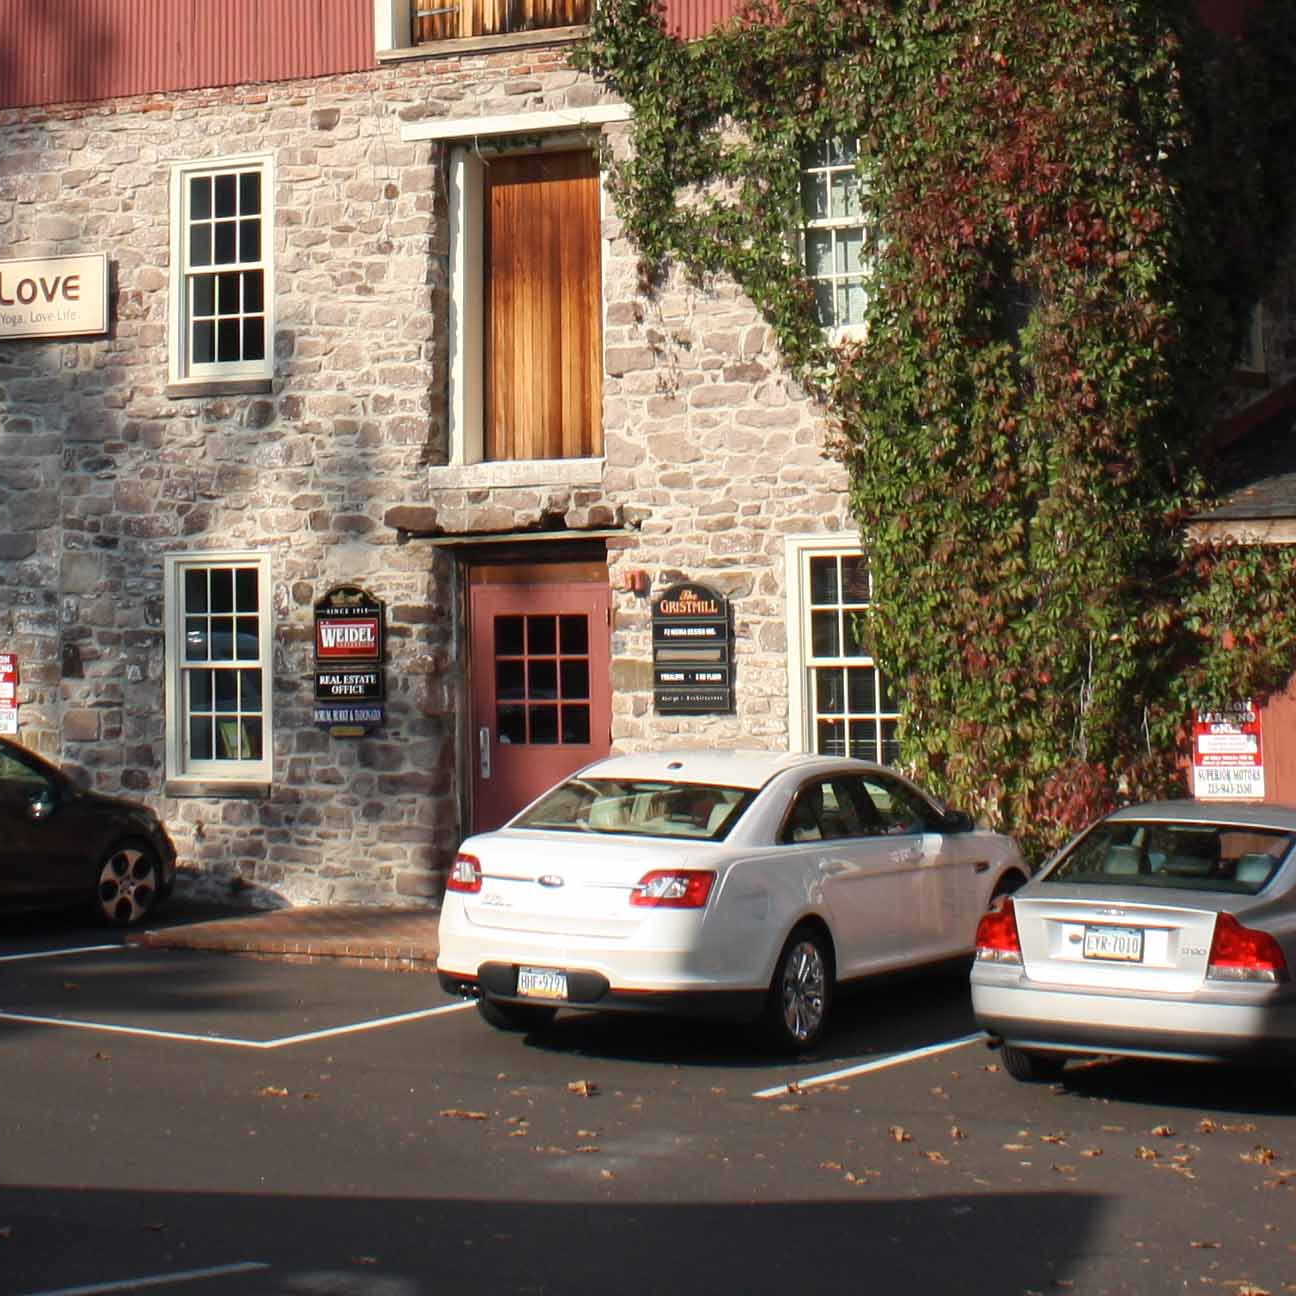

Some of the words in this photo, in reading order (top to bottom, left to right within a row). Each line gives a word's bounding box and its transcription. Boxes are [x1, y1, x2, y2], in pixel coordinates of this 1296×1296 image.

[30, 311, 54, 323] Love
[680, 589, 698, 601] The
[660, 600, 718, 613] GRISTMILL
[320, 627, 375, 648] WEIDEL
[319, 675, 342, 685] REAL
[344, 674, 376, 685] ESTATE
[331, 685, 364, 695] OFFICE
[1198, 768, 1230, 781] SUPERIOR
[1233, 768, 1261, 781] MOTORS
